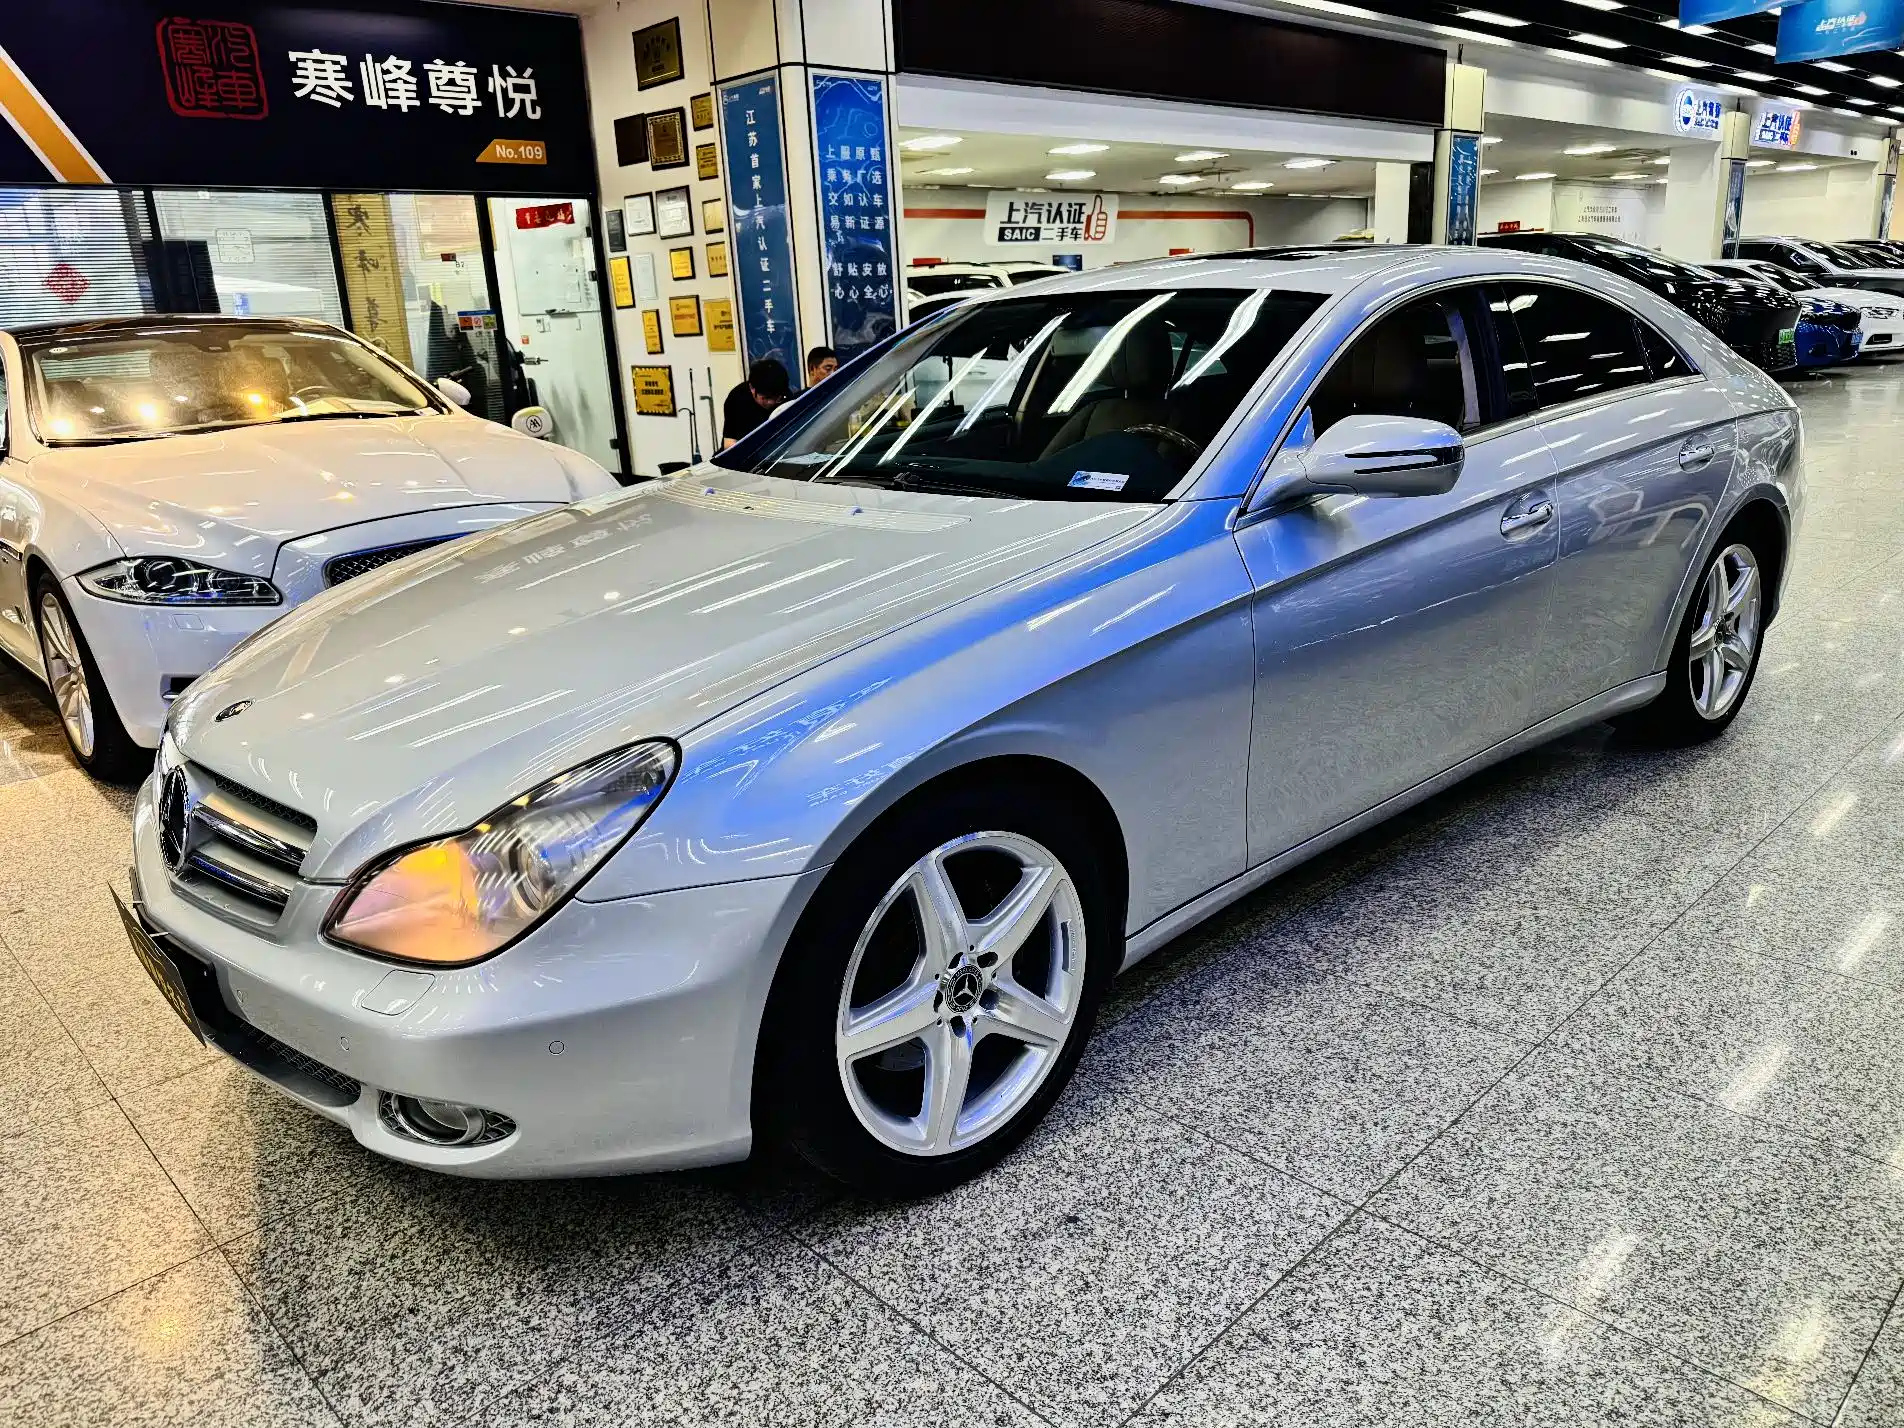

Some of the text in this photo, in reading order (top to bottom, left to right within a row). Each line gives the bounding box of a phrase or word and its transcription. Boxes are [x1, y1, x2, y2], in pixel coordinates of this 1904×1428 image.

[288, 48, 543, 120] 寒峰尊悦
[495, 144, 544, 160] No.109
[1000, 201, 1087, 225] 上汽认证
[1003, 226, 1083, 242] SAIC 二手车
